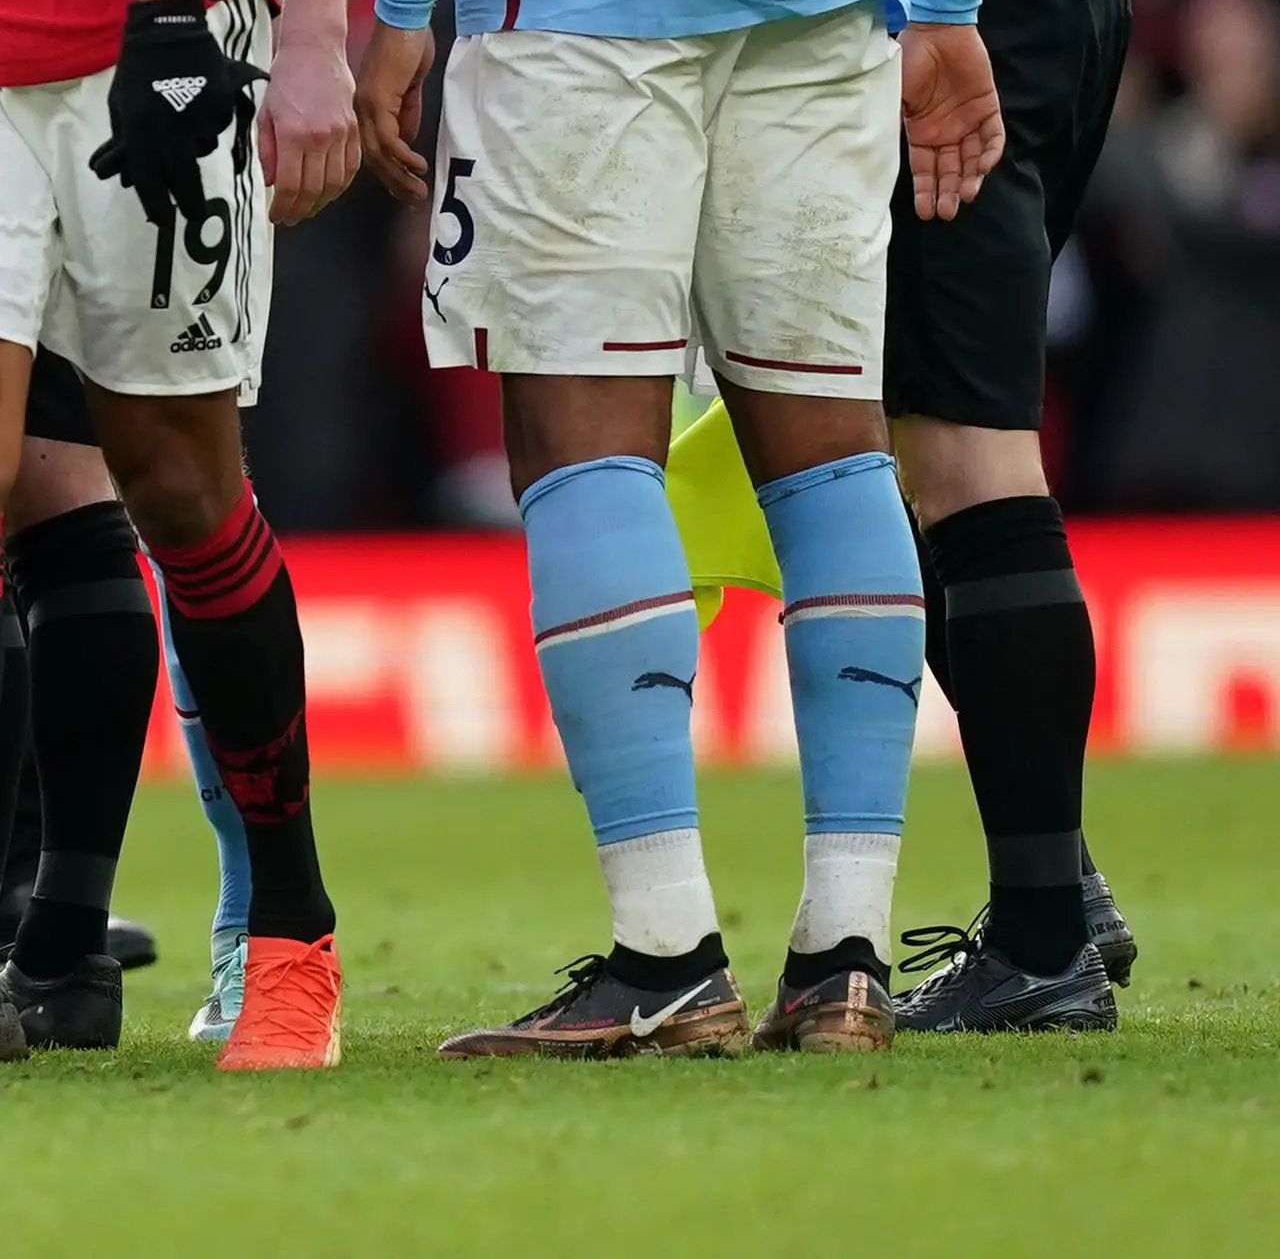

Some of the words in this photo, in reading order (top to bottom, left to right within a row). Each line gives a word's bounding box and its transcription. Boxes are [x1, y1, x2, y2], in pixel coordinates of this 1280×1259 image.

[152, 76, 207, 92] adidas
[148, 197, 232, 309] 19
[170, 338, 222, 353] adidas
